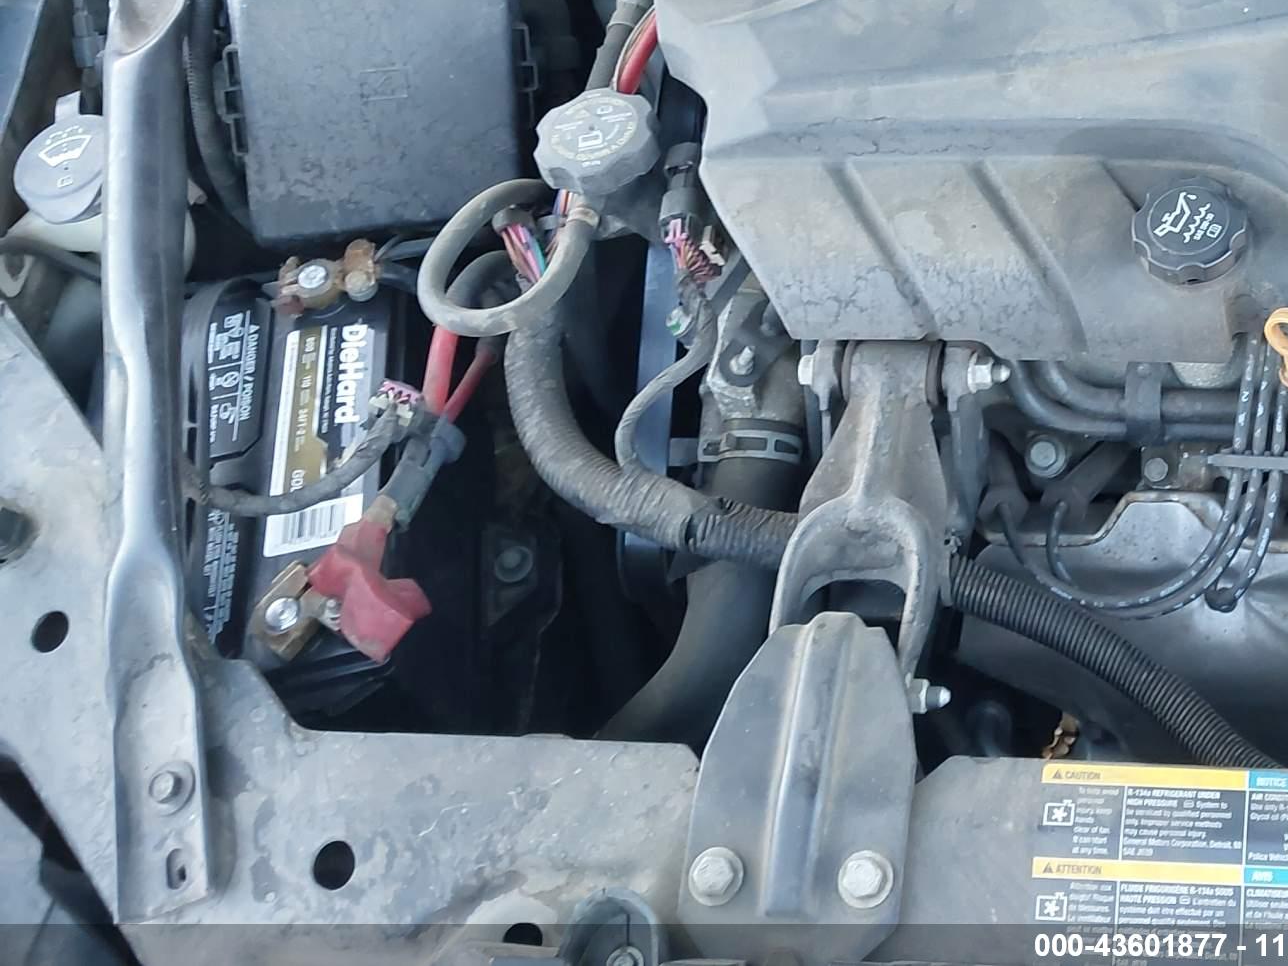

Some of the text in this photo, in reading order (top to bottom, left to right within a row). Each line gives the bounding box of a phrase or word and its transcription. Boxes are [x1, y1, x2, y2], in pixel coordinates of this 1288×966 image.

[244, 333, 259, 374] DANGER
[333, 323, 369, 425] DieHard
[238, 382, 254, 421] POISON
[289, 468, 306, 493] GOL
[1065, 771, 1101, 780] CAUTION
[1256, 777, 1288, 787] NOTICE
[1055, 865, 1102, 874] ATTENTION
[1252, 871, 1273, 882] AVIS
